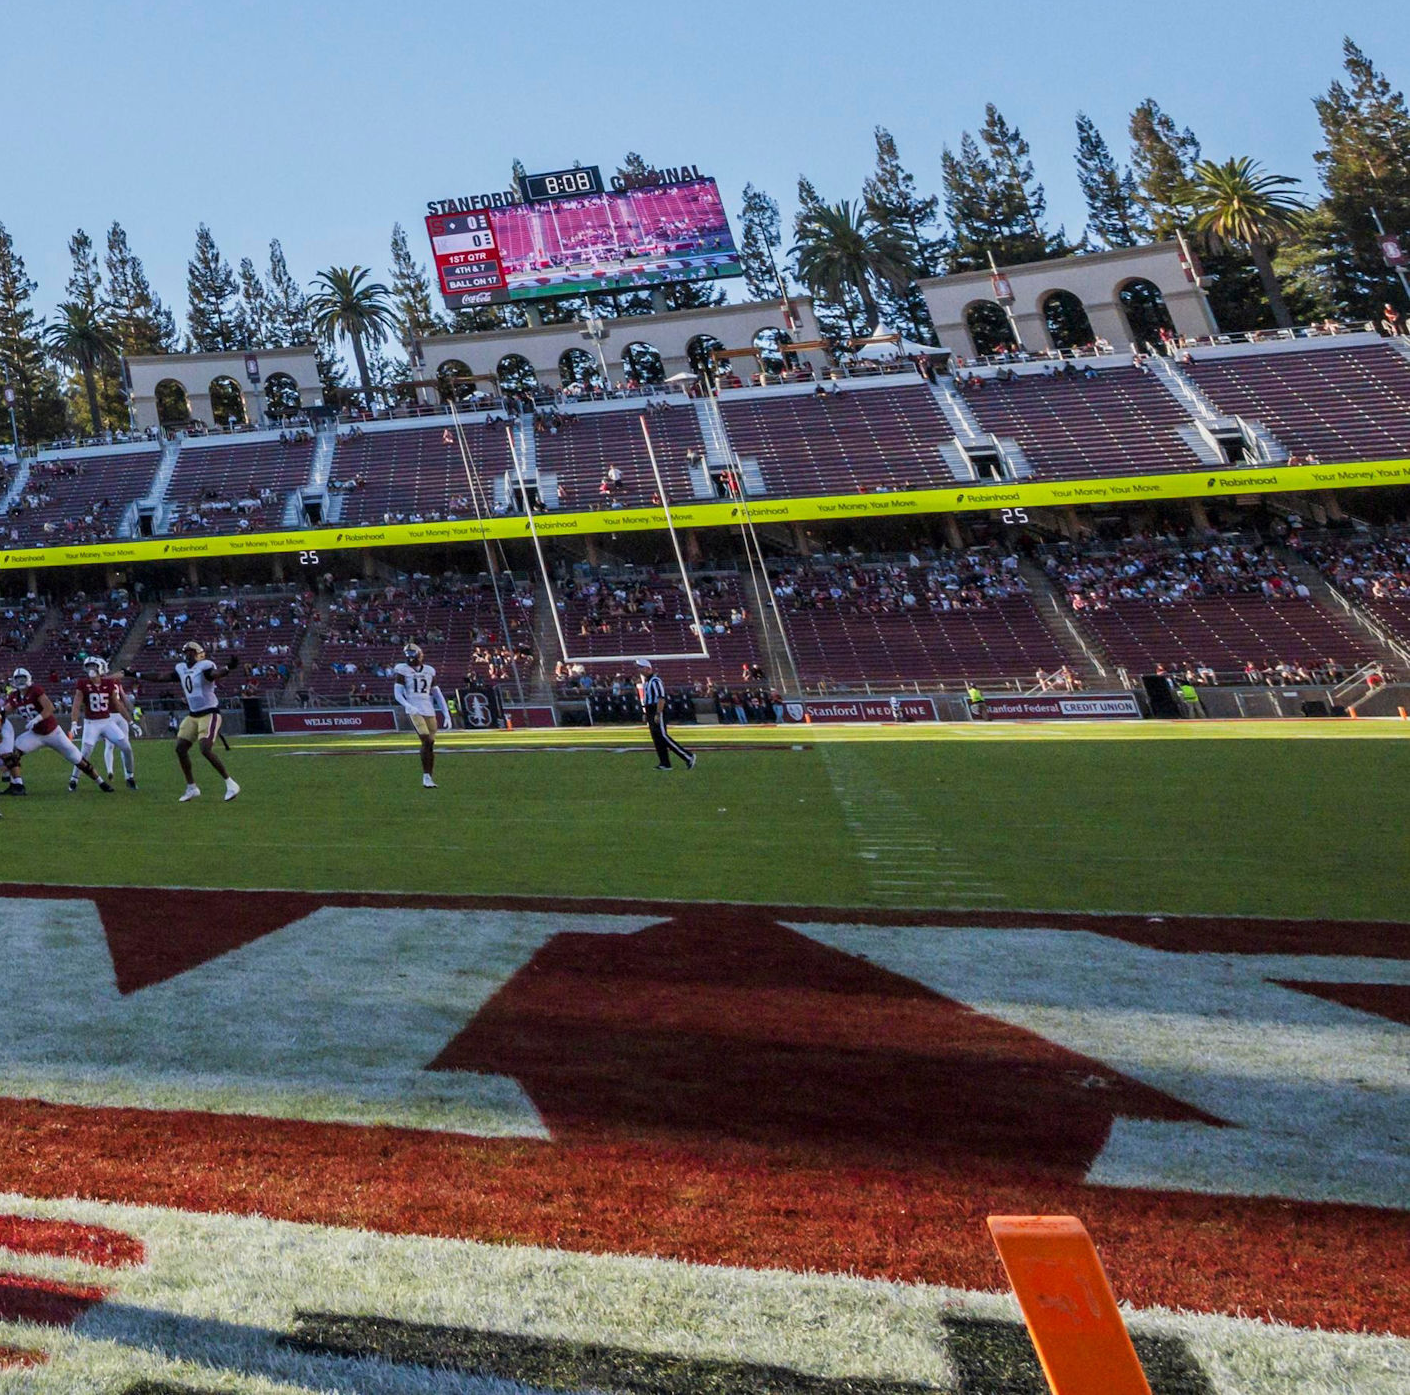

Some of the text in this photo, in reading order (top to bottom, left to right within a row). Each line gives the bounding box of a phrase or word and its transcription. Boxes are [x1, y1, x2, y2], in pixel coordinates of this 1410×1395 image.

[545, 172, 590, 195] 8:08
[427, 190, 515, 216] STANFORD
[467, 216, 478, 230] 0
[472, 234, 482, 247] 0
[449, 252, 487, 264] 1ST QTR
[454, 265, 472, 274] 4TH
[449, 276, 497, 289] BALL ON 17
[1311, 473, 1336, 482] Your
[1376, 468, 1398, 477] Your
[1219, 477, 1278, 487] Robinhood
[1051, 489, 1072, 498] Your
[1109, 485, 1131, 495] Your
[967, 493, 1020, 503] Robinhood
[817, 504, 837, 512] Your
[870, 501, 889, 509] Your
[1001, 507, 1029, 524] 25
[534, 520, 578, 529] Robinhood
[345, 533, 385, 542] Robinhood
[408, 530, 425, 538] Your
[451, 527, 469, 535] Your
[171, 544, 208, 552] Robinhood
[229, 541, 244, 549] Your
[11, 555, 45, 563] Robinhood
[299, 550, 320, 565] 25
[185, 675, 192, 694] 0
[413, 678, 427, 694] 12
[89, 692, 110, 712] 85
[1063, 700, 1134, 712] CREDIT UNION
[807, 705, 858, 717] Stanford
[865, 706, 926, 716] MEDINE
[985, 703, 1059, 714] tanford Federal
[303, 717, 362, 726] WELLS FARGO
